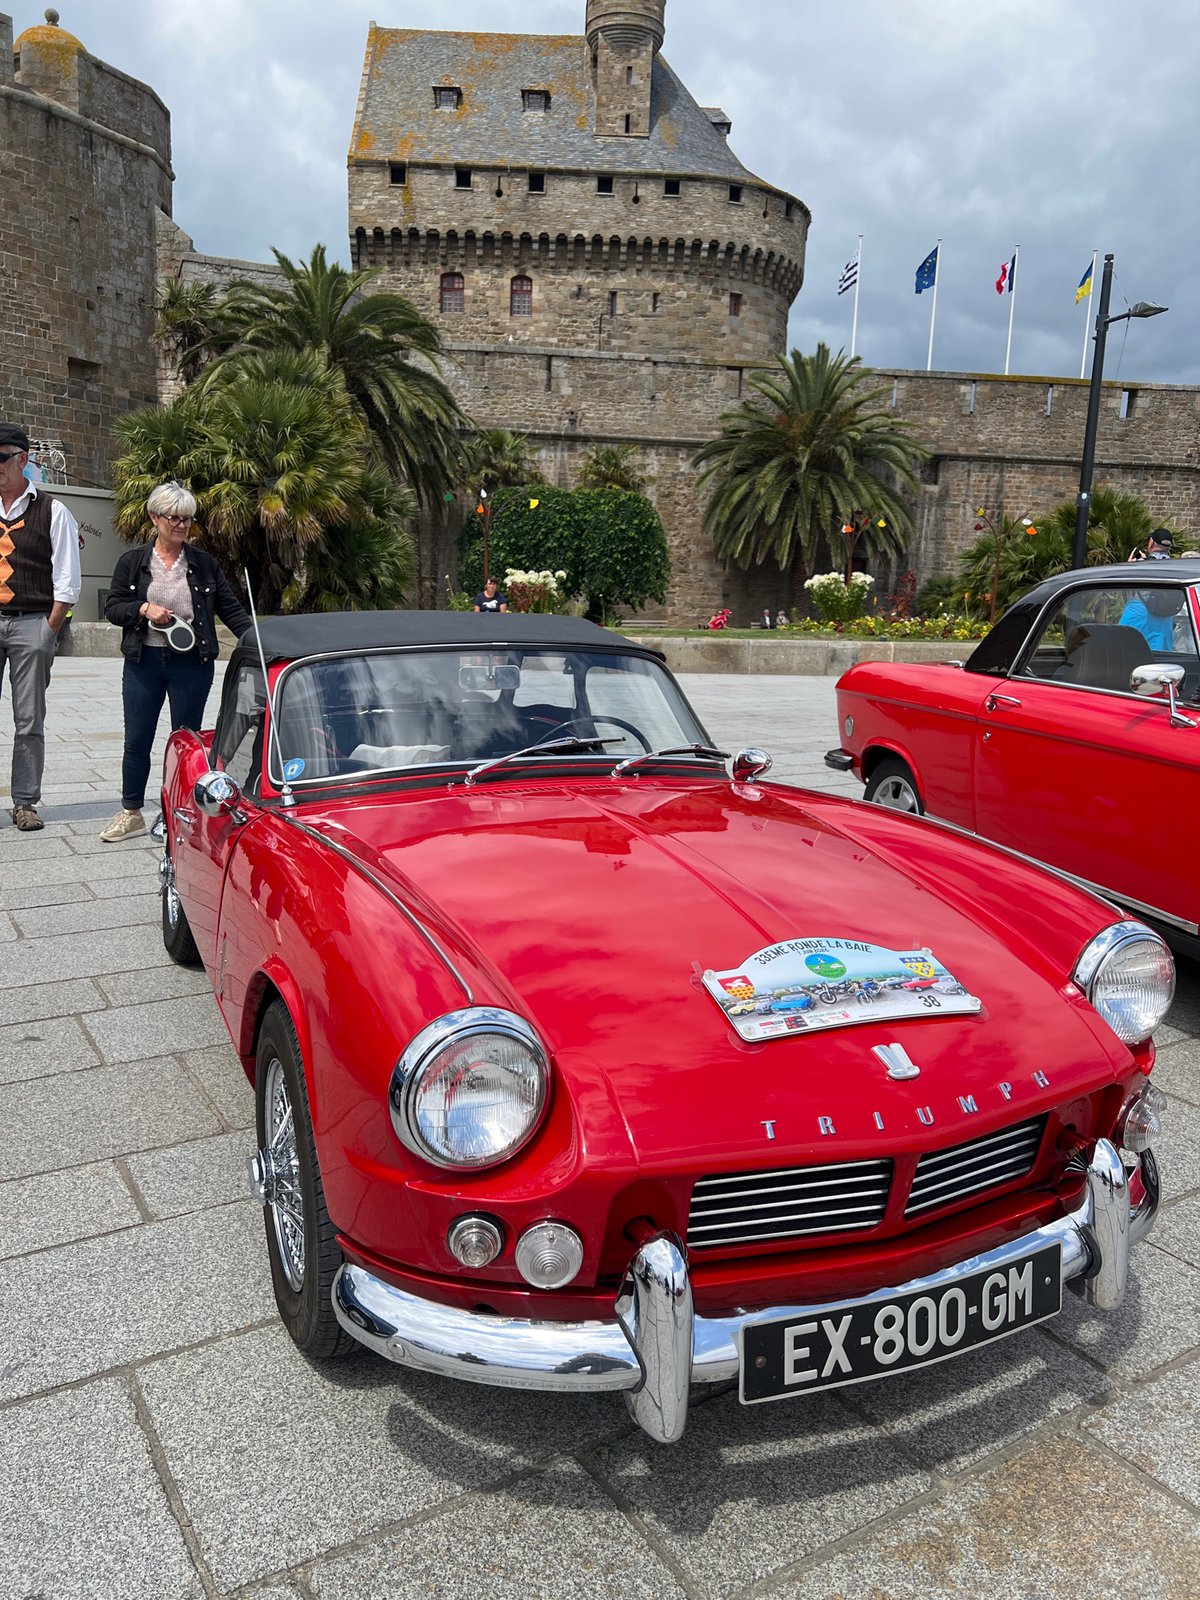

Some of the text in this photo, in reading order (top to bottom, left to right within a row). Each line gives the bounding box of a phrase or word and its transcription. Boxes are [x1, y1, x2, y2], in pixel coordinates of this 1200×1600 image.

[754, 940, 873, 965] 33EME RONDE LA BAIE
[918, 994, 942, 1008] 38
[760, 1070, 1050, 1140] TRIUMPH
[784, 1260, 1033, 1385] EX-800-GM
